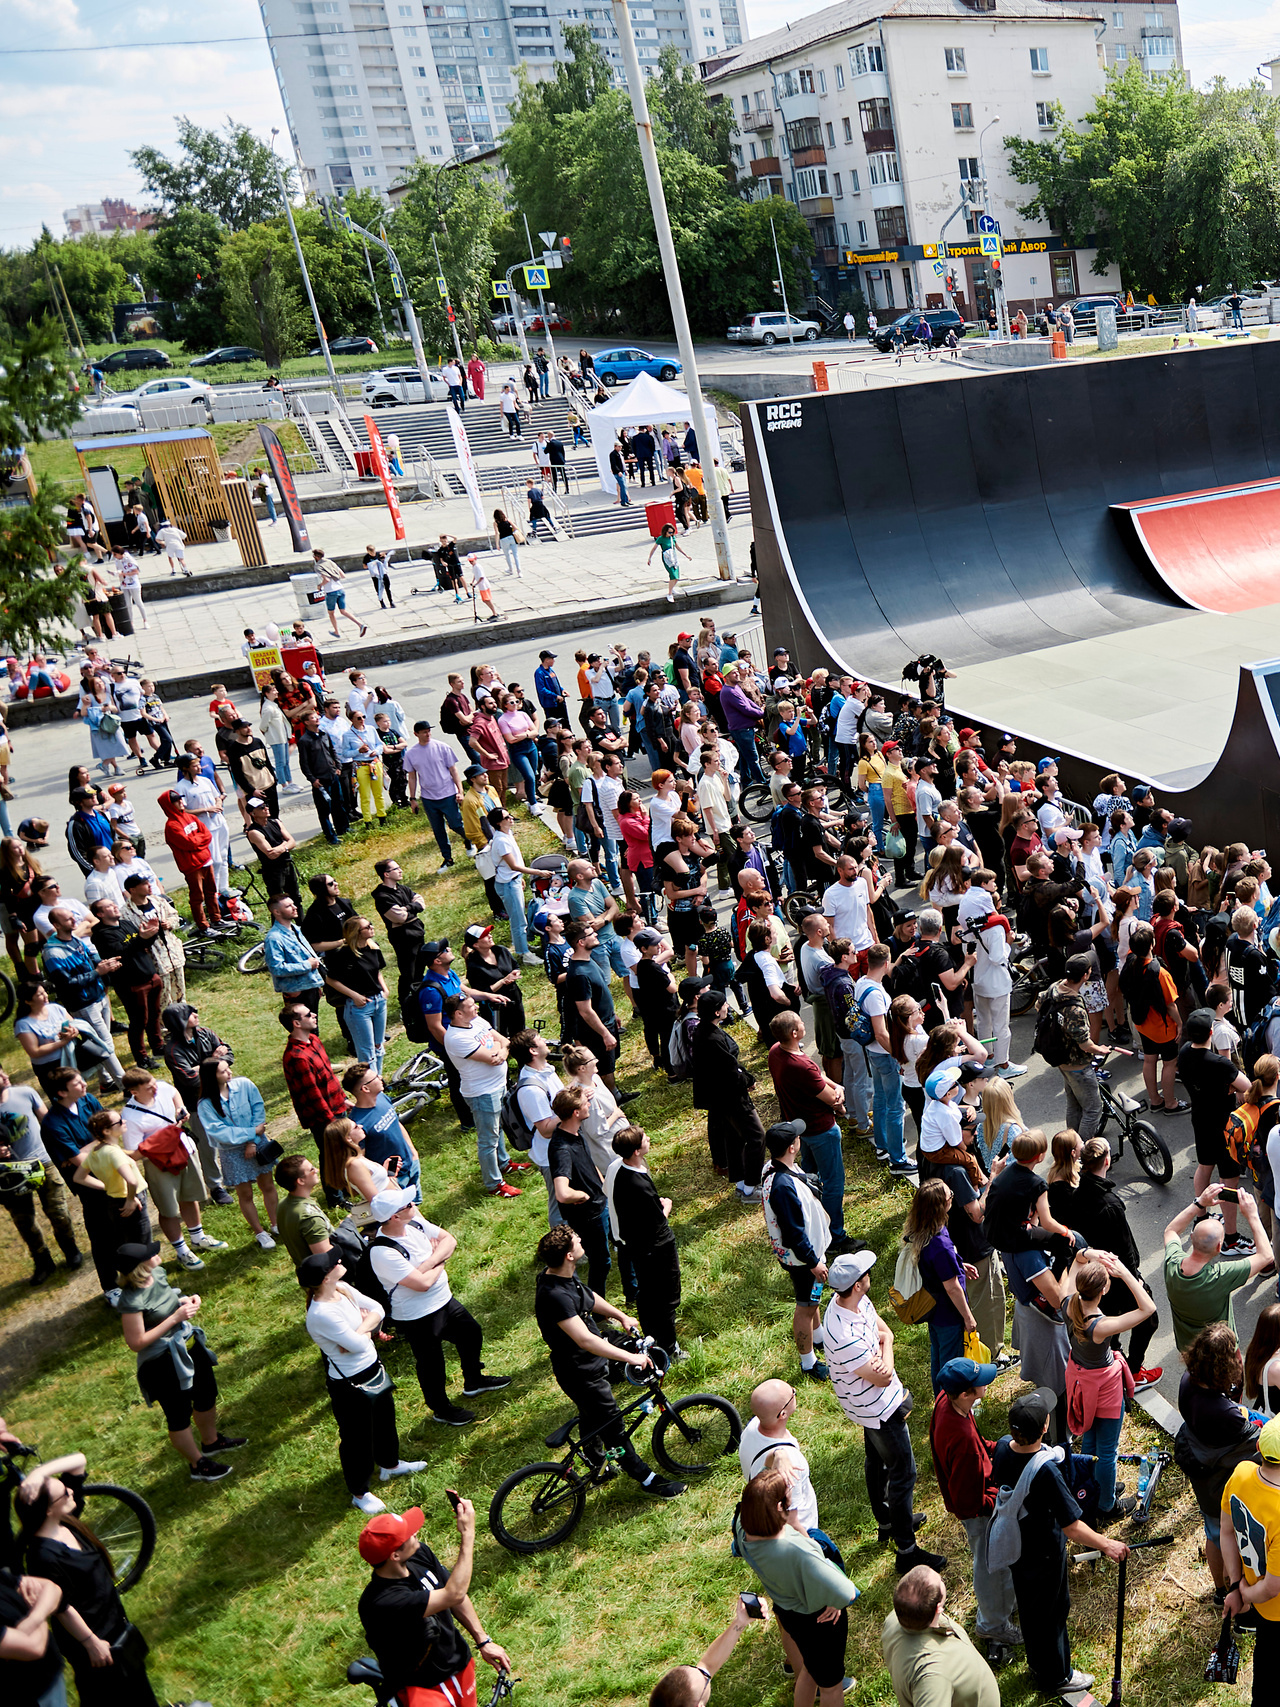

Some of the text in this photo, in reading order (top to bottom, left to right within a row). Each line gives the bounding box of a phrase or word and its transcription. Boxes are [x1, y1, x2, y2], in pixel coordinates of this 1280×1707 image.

[1020, 241, 1047, 253] Двор
[885, 250, 899, 263] Двор
[766, 402, 802, 421] RCC
[767, 418, 803, 432] EXTREME
[253, 650, 276, 658] СЛАДКАЯ
[255, 657, 277, 666] ВАТА
